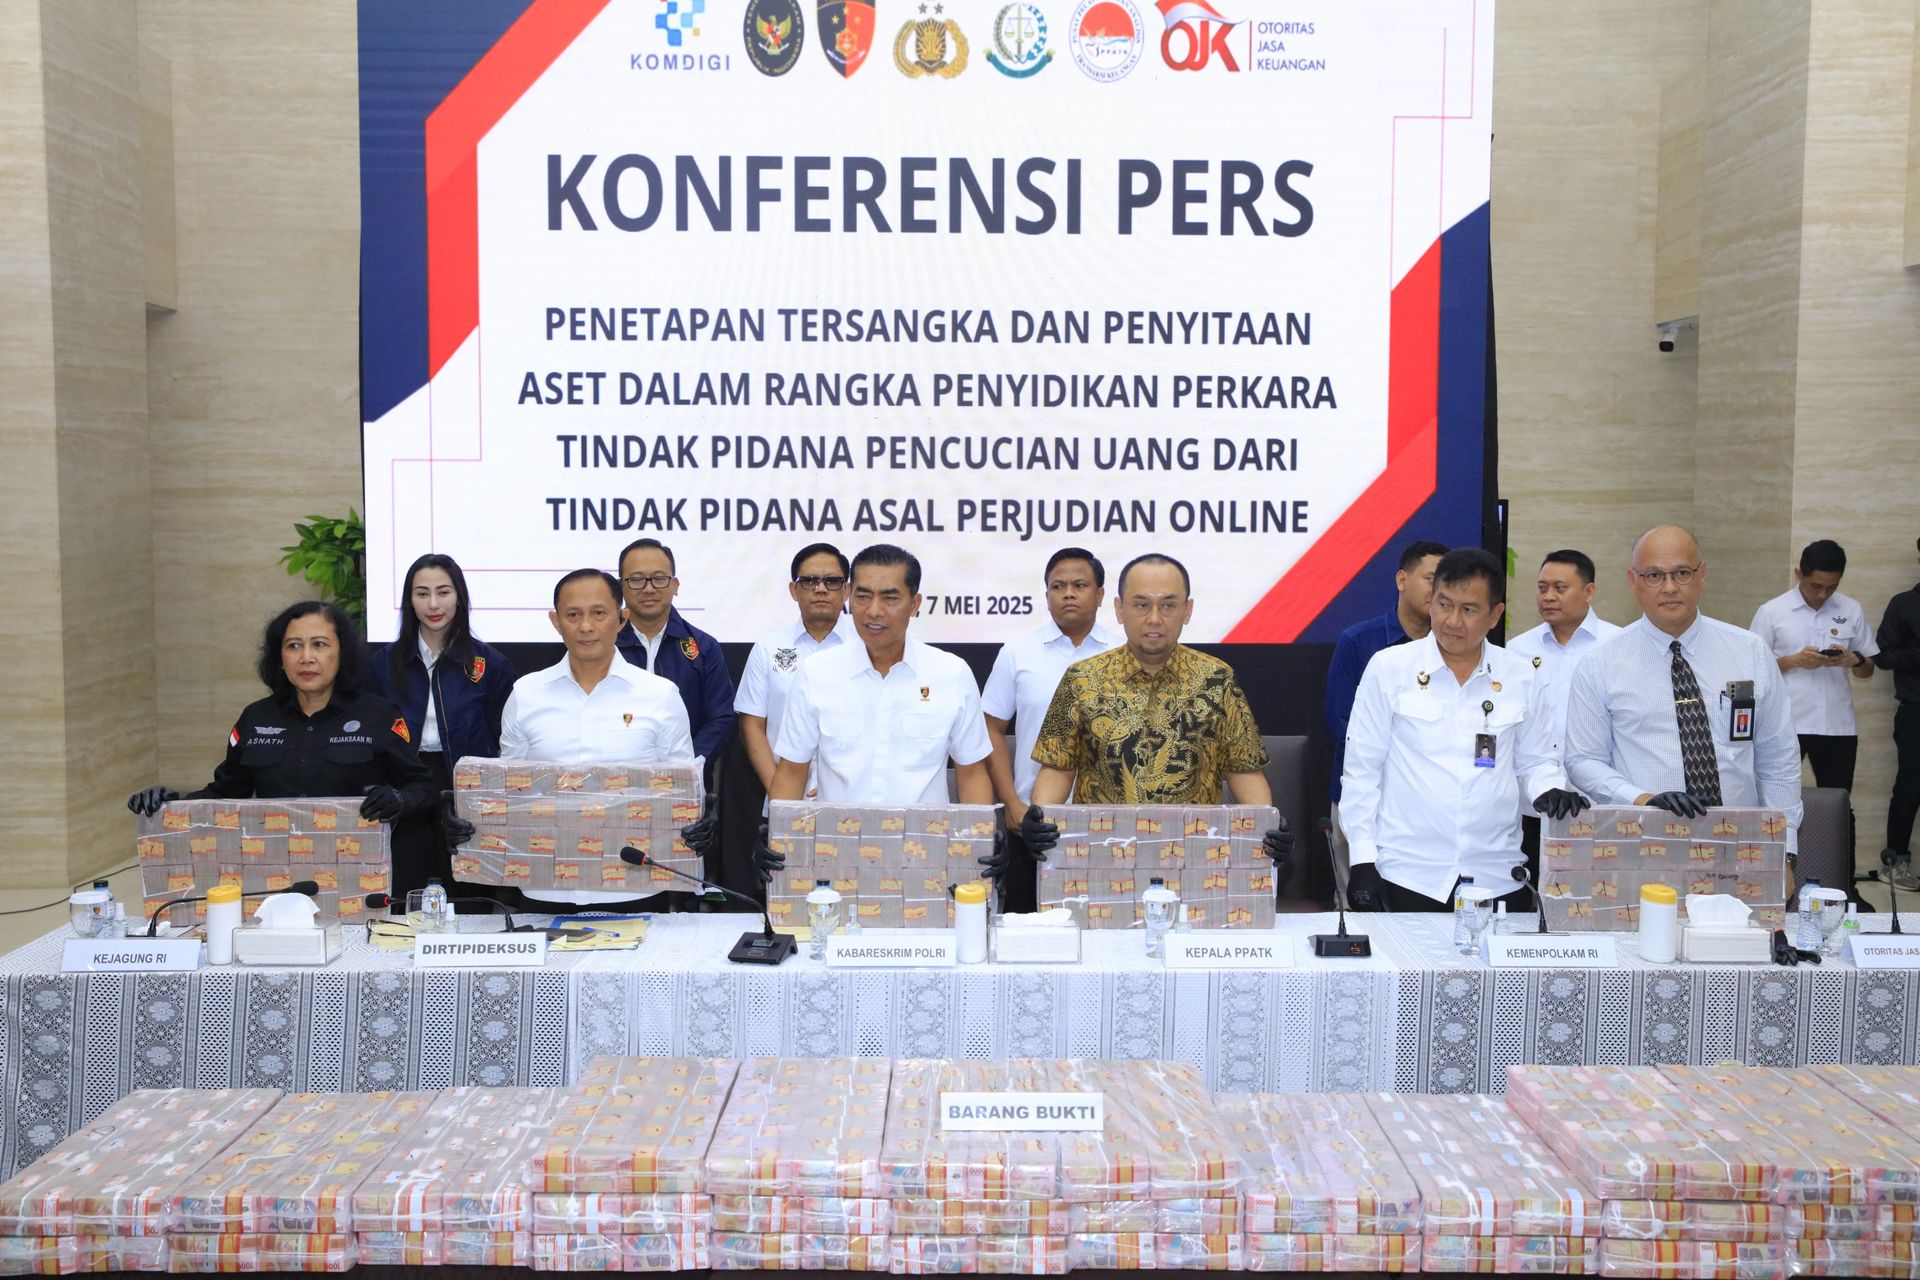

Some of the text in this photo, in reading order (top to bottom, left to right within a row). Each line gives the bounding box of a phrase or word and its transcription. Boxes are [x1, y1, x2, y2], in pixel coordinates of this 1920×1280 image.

[1257, 21, 1315, 35] OTORITAS
[1160, 19, 1241, 72] OJK
[1257, 39, 1286, 53] JASA
[630, 53, 730, 71] KOMDIGI
[1257, 57, 1326, 72] KEUANGAN
[547, 153, 1314, 238] KONFERENSI PERS
[546, 307, 1311, 346] PENETAPAN TERSANGKA DAN PENYITAAN
[517, 371, 1338, 409] ASET DALAM RANGKA PENYIDIKAN PERKARA
[556, 434, 1298, 472] TINDAK PIDANA PENCUCIAN UANG DARI
[545, 497, 1309, 542] TINDAK PIDANA ASAL PERJUDIAN ONLINE
[926, 595, 939, 615] 7
[944, 595, 980, 615] MEI
[986, 595, 1033, 615] 2025
[246, 737, 284, 746] ASNATH
[329, 735, 373, 744] KEJAKSAAN RI
[422, 943, 537, 955] DIRTIPIDEKSUS
[837, 948, 946, 958] KABARESKRIM POLRI
[1185, 947, 1273, 958] KEPALA PPATK
[1506, 948, 1599, 959] KEMENPOLKAM RI
[1863, 947, 1920, 956] OTORITAS JAS
[93, 953, 168, 964] KEJAGUNG RI
[948, 1105, 1096, 1120] BARANG BUKTI
